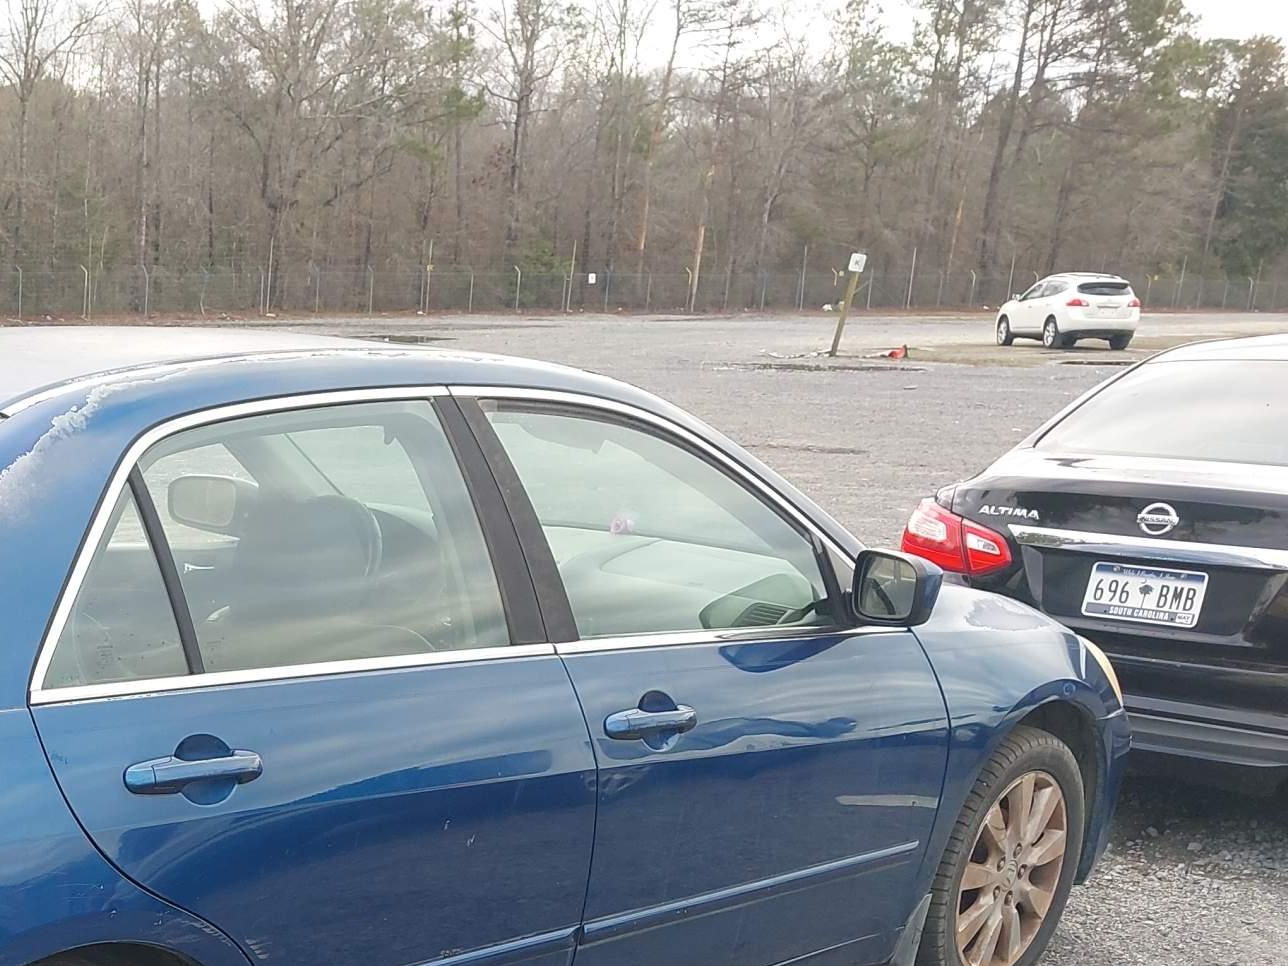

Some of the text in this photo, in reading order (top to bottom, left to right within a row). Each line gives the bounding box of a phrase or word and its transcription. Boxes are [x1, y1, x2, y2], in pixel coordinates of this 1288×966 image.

[978, 504, 1040, 520] ALTIMA
[1139, 515, 1176, 526] NISSAN
[1094, 578, 1197, 611] 696 BMB
[1109, 606, 1169, 620] SOUTH CAROLINA
